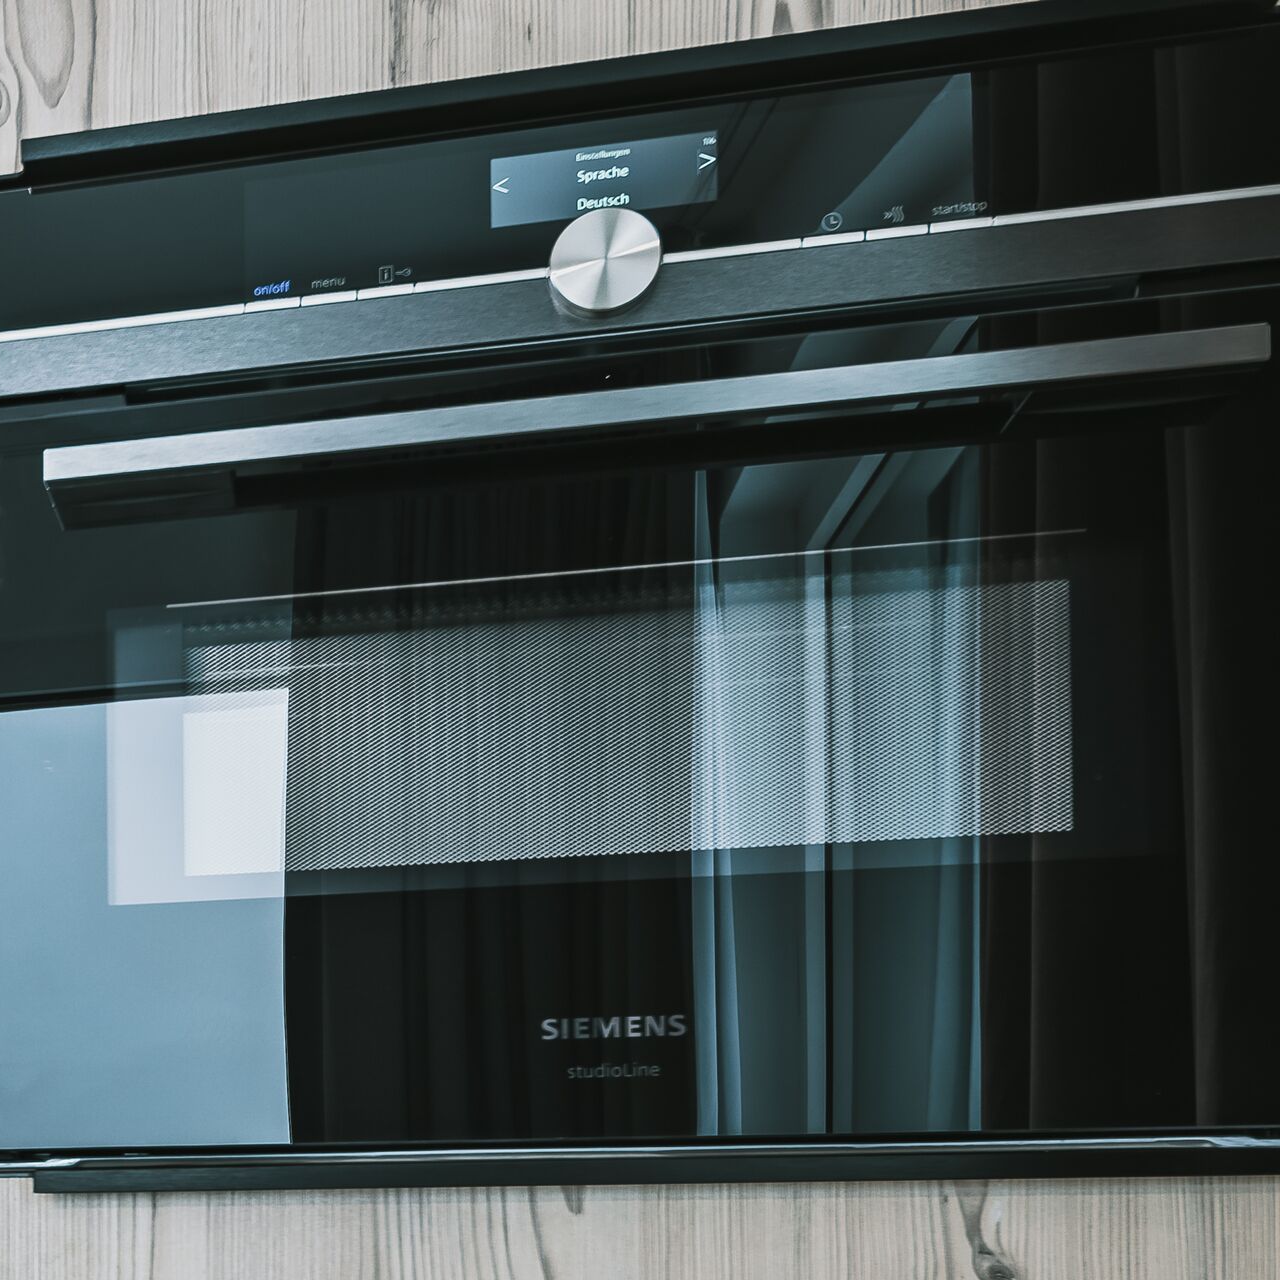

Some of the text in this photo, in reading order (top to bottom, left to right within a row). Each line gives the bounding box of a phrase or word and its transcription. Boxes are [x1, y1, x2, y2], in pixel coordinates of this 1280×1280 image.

[576, 165, 630, 184] Sprache
[576, 193, 630, 210] Deutsch
[931, 200, 988, 217] start/stop
[253, 279, 291, 297] on/off
[310, 276, 347, 290] menu
[541, 1014, 687, 1040] SIEMENS
[566, 1062, 662, 1079] studioLine
